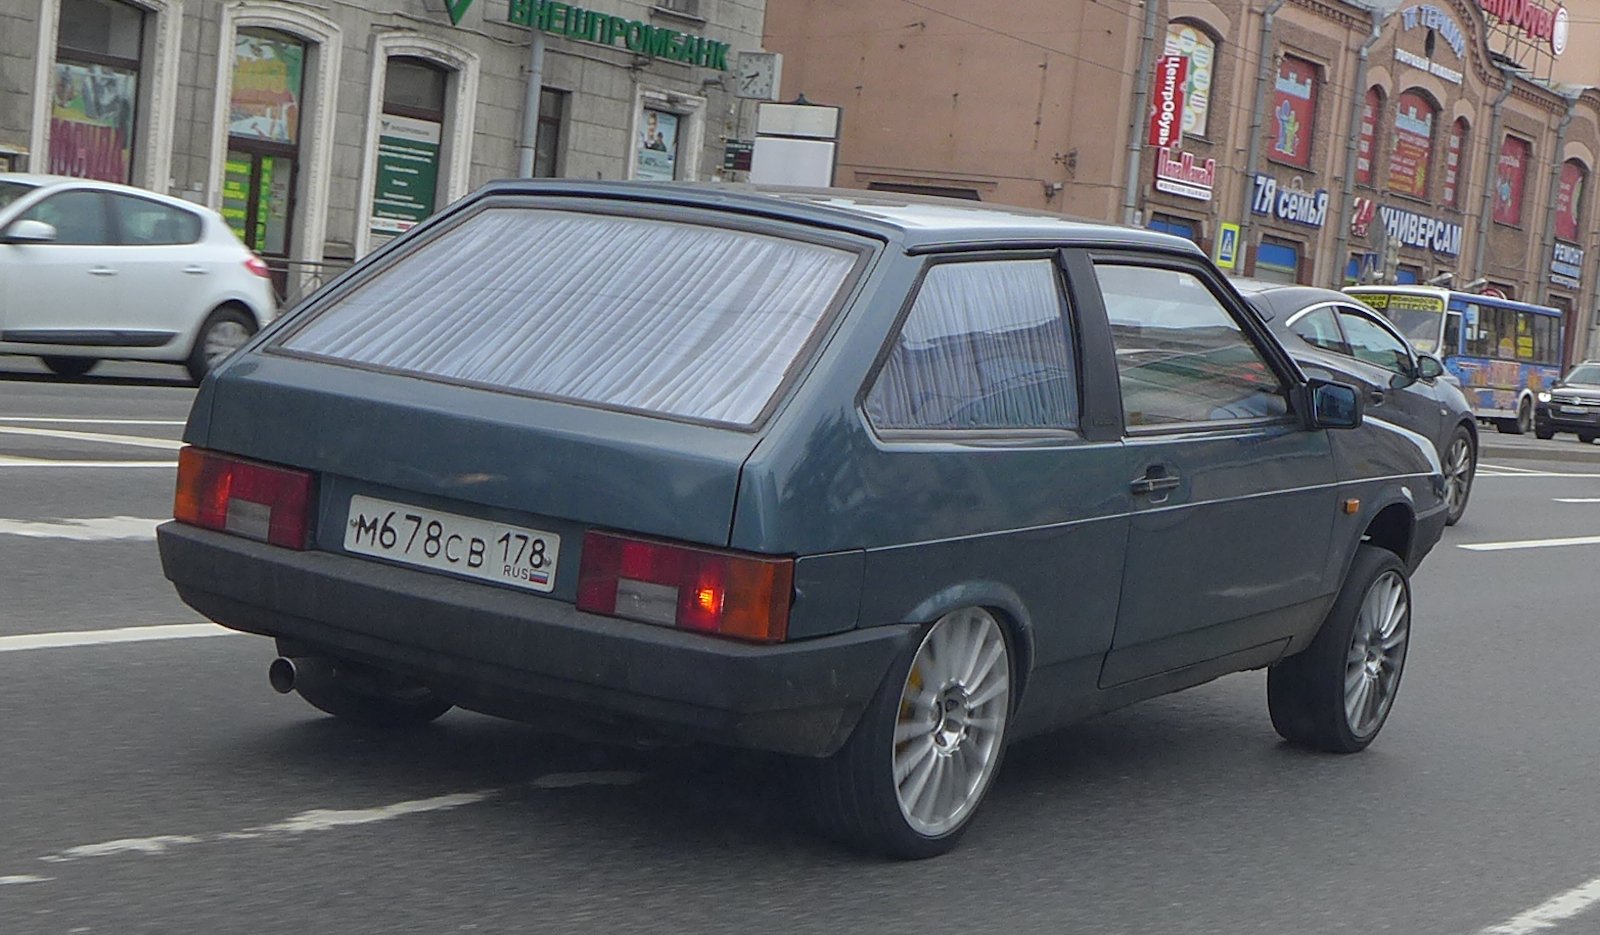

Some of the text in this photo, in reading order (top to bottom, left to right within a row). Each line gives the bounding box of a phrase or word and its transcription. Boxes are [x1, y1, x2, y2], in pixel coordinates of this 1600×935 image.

[508, 0, 731, 71] ВНЕШПРОМБАНК
[1480, 0, 1553, 41] ентрОбувь
[1158, 57, 1180, 145] ЦентрОбувь
[1254, 175, 1329, 226] 7Я семьЯ
[1380, 206, 1463, 255] УНИВЕРСАМ
[355, 511, 546, 569] М678СВ 178
[503, 565, 528, 580] RUS
